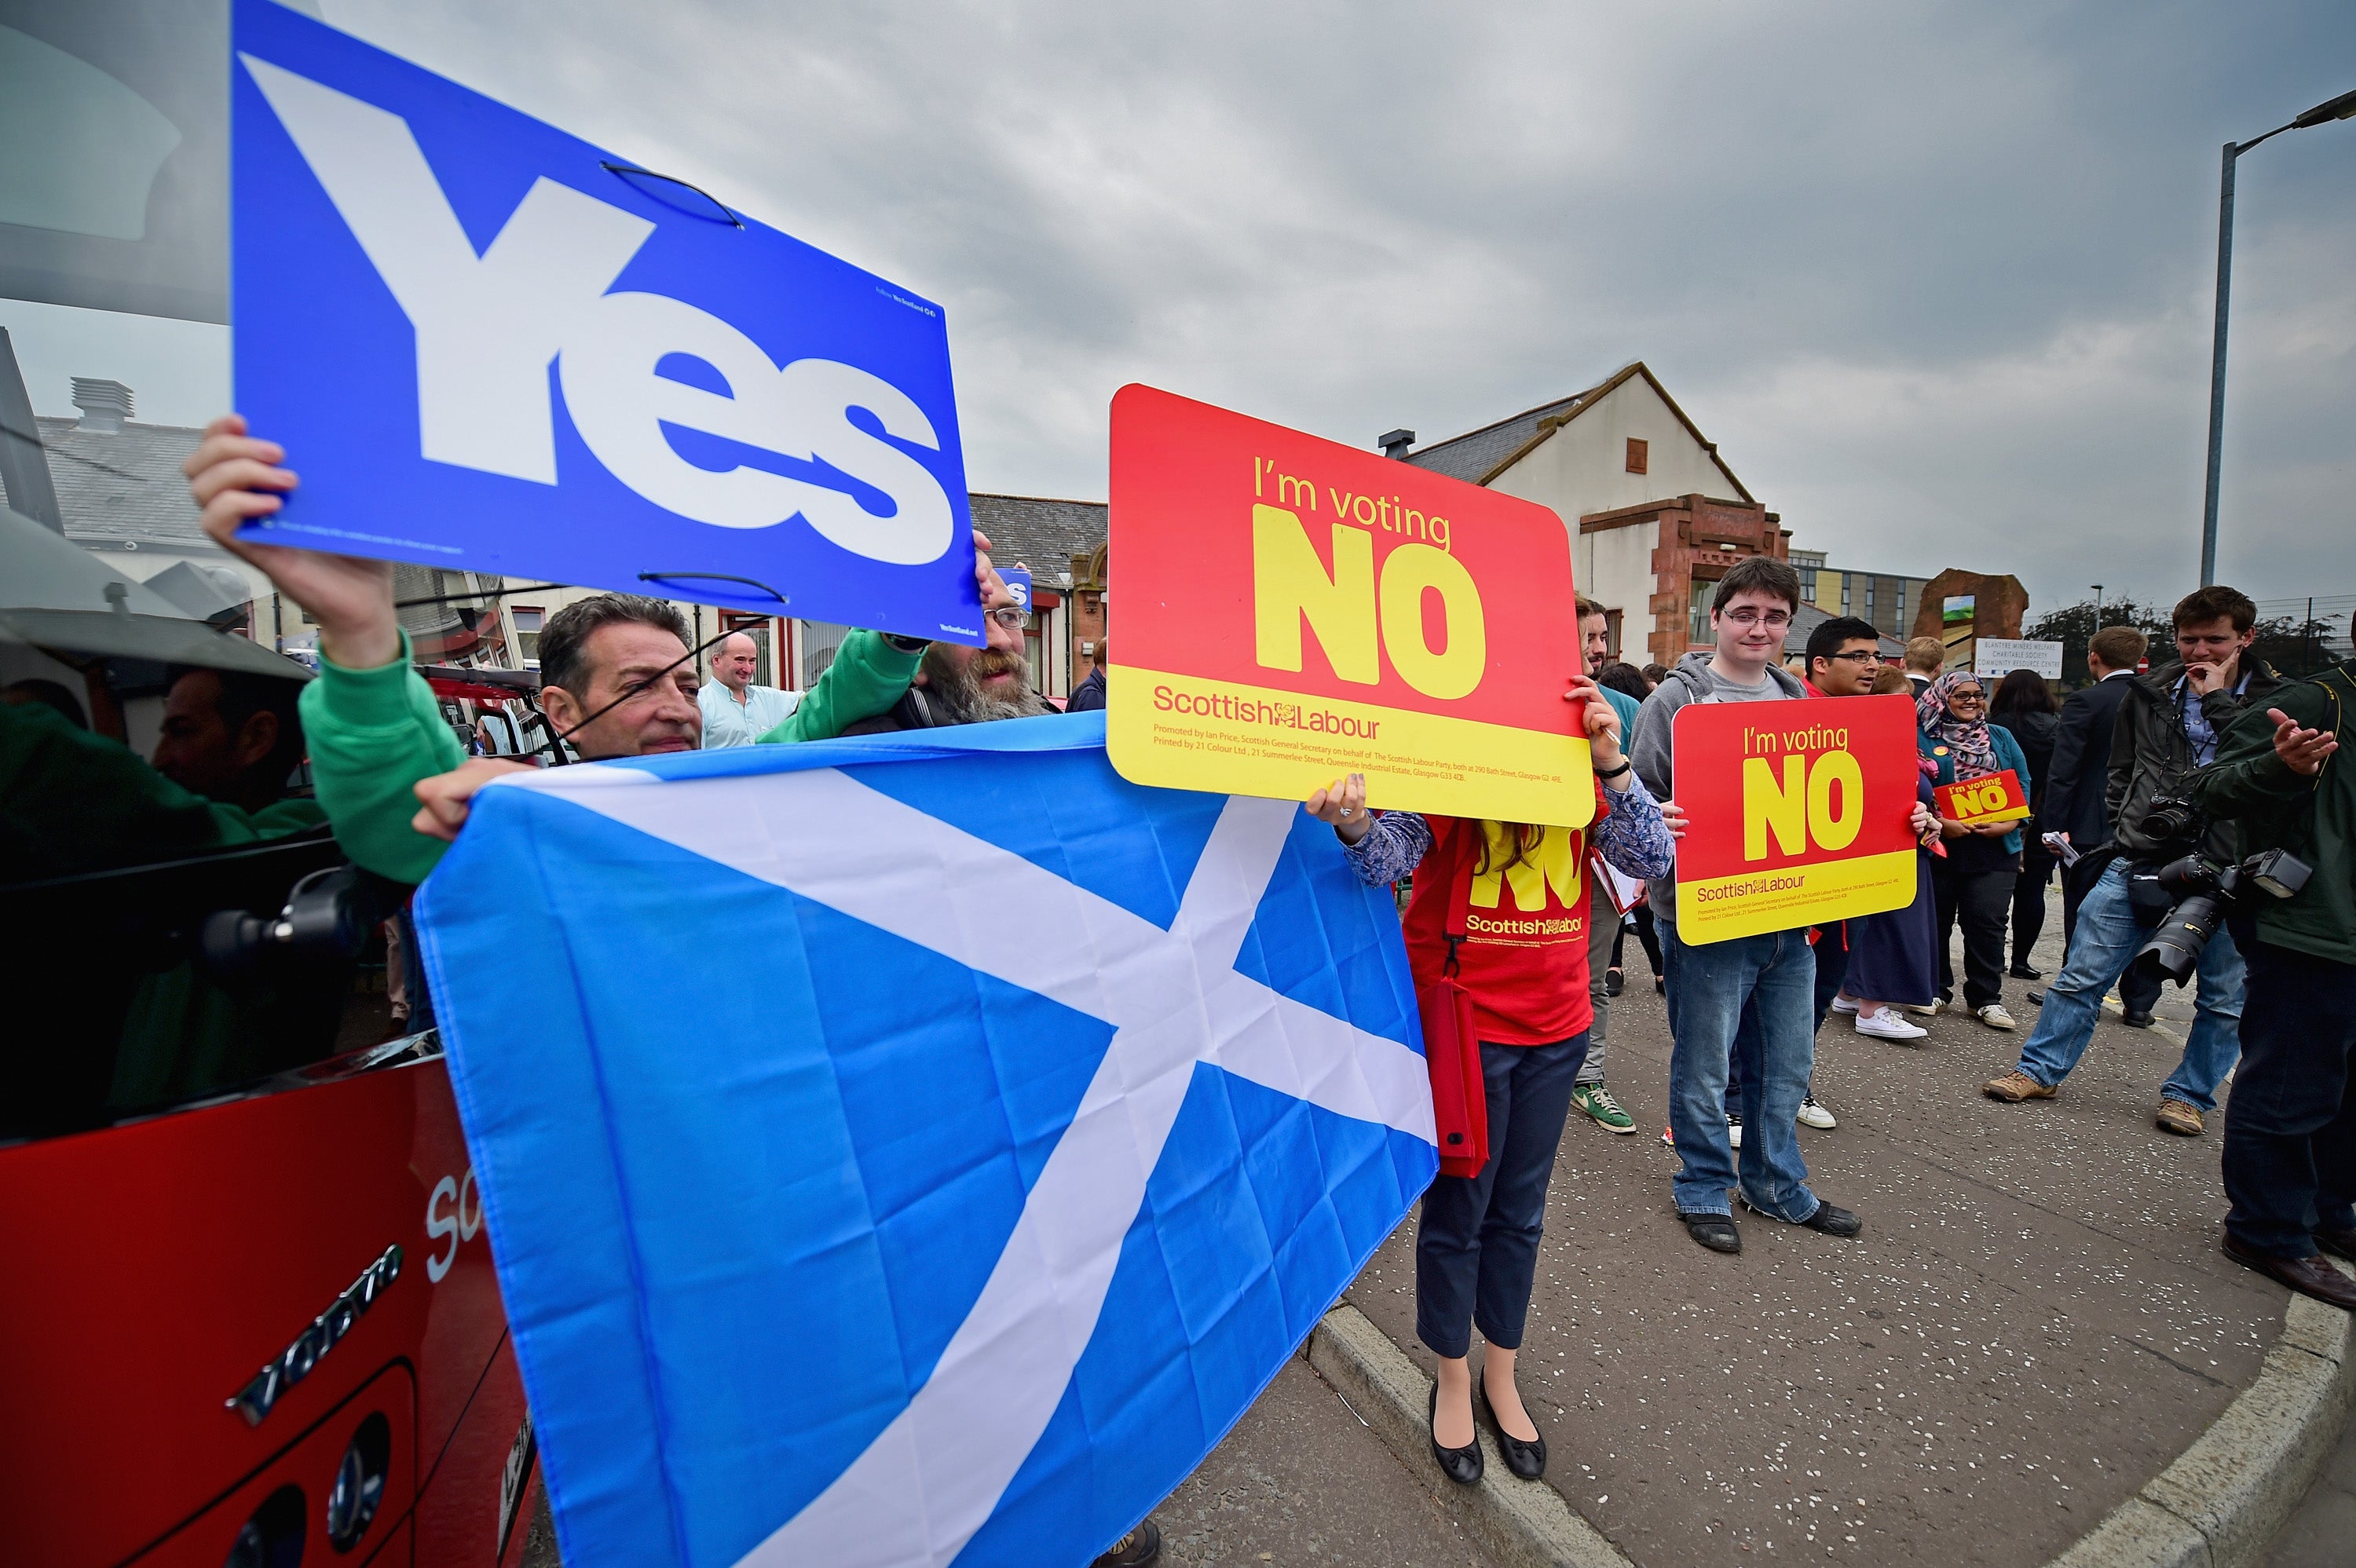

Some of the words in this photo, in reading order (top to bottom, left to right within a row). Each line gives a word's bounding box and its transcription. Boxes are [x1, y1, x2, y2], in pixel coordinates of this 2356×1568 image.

[236, 51, 953, 565] Yes
[1255, 455, 1317, 511] I’m
[1330, 488, 1451, 554] voting
[1252, 503, 1487, 701] NO
[1977, 659, 2011, 667] COMMUNITY
[2013, 660, 2040, 668] RESOURCE
[1992, 650, 2024, 659] CHARITABLE
[1154, 685, 1274, 726] Scottish
[1297, 706, 1380, 740] Labour
[1153, 736, 1182, 747] Printed
[1184, 740, 1194, 751] by
[1195, 741, 1205, 750] 21
[1207, 743, 1232, 754] Colour
[1251, 748, 1260, 757] 21
[1262, 749, 1302, 762] Summerlee
[1304, 755, 1326, 766] Street,
[1326, 758, 1360, 769] Queenslie
[1361, 762, 1391, 773] Industrial
[1392, 766, 1412, 776] Estate,
[1413, 769, 1439, 779] Glasgow
[1154, 723, 1193, 736] Promoted
[1194, 729, 1204, 740] by
[1206, 730, 1217, 740] Ian
[1220, 732, 1240, 743] Price,
[1242, 734, 1270, 746] Scottish
[1271, 738, 1299, 750] General
[1301, 742, 1331, 755] Secretary
[1344, 748, 1364, 758] behalf
[1374, 752, 1386, 761] The
[1388, 754, 1412, 764] Scottish
[1414, 757, 1434, 767] Labour
[1436, 760, 1452, 770] Party,
[1453, 762, 1467, 771] both
[1518, 771, 1541, 781] Glasgow
[1744, 726, 1776, 755] I’m
[1783, 722, 1848, 752] voting
[1951, 785, 2008, 819] NO
[1967, 777, 2002, 789] voting
[1743, 750, 1864, 861] NO
[1697, 880, 1754, 902] Scottish
[1764, 874, 1805, 893] Labour
[1466, 915, 1546, 935] Scottish
